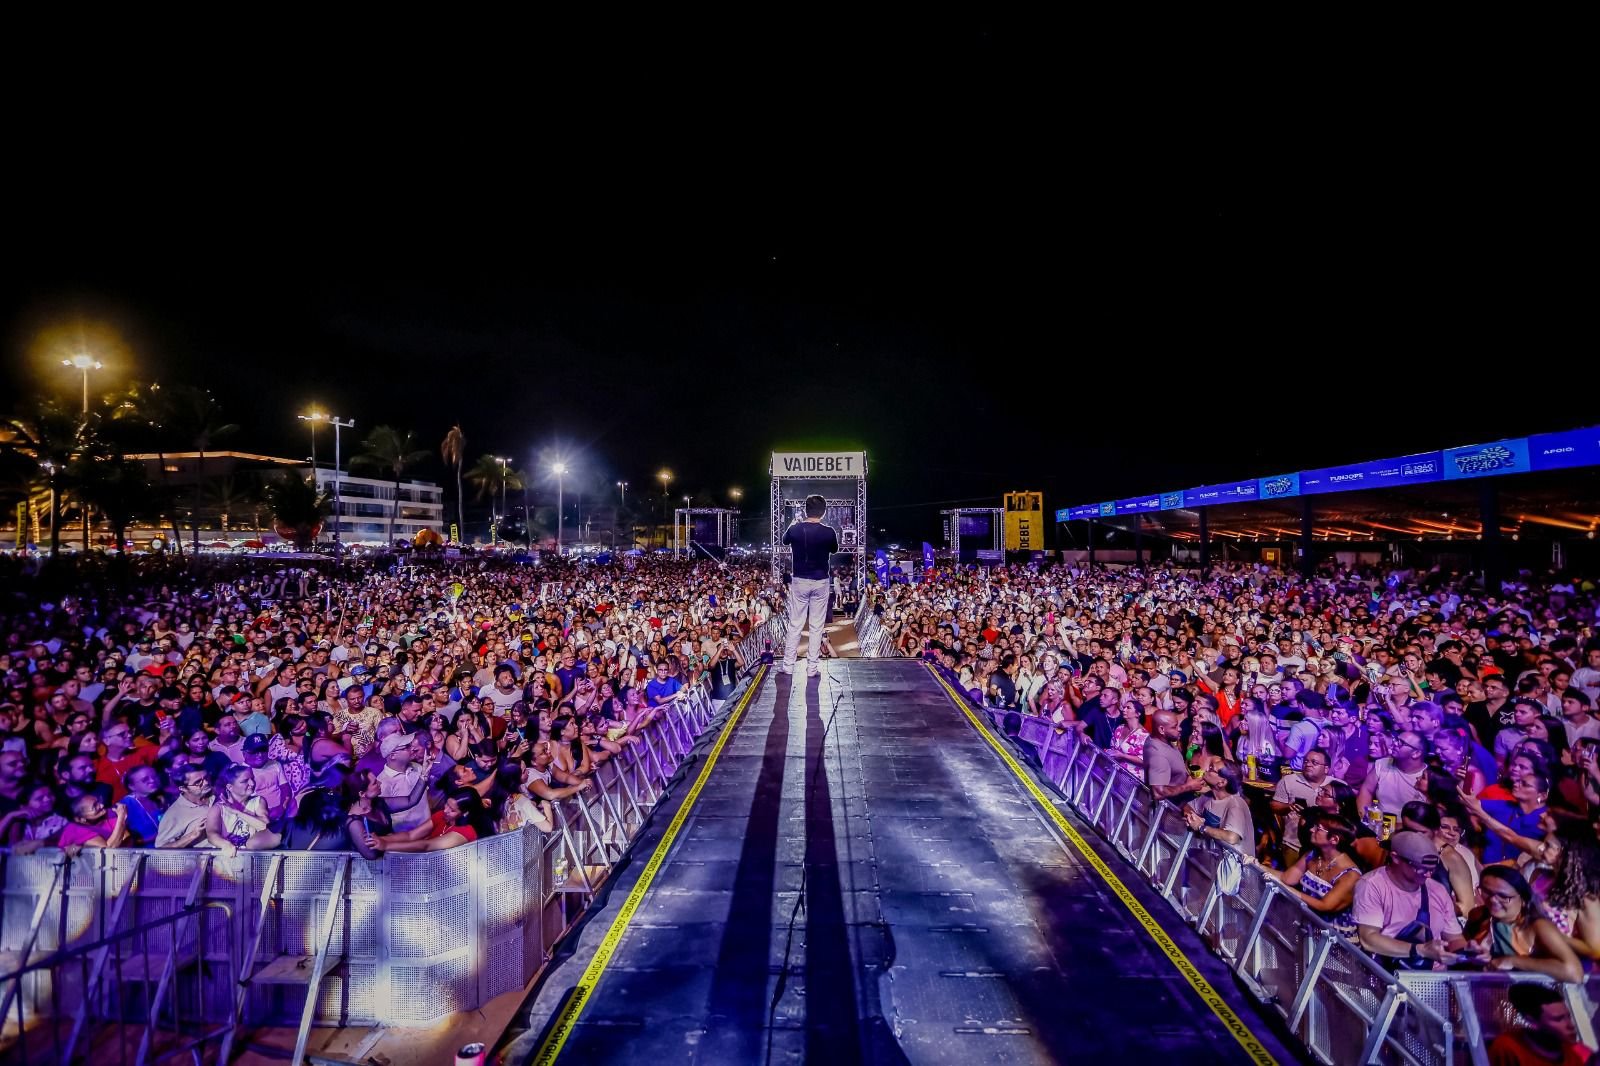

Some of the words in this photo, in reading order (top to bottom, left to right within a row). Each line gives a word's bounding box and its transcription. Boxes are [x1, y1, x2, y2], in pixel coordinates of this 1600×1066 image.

[783, 457, 853, 471] VAIDEBET
[564, 984, 591, 1021] CUIDADO
[586, 949, 610, 981] CUIDADO
[605, 920, 626, 947] CUIDADO
[621, 894, 640, 919] CUIDADO
[1110, 878, 1132, 899] CUIDADO
[1129, 901, 1154, 926] CUIDADO
[1151, 928, 1180, 957] CUIDADO
[1177, 960, 1210, 994] CUIDADO
[1209, 998, 1249, 1038] CUIDADO
